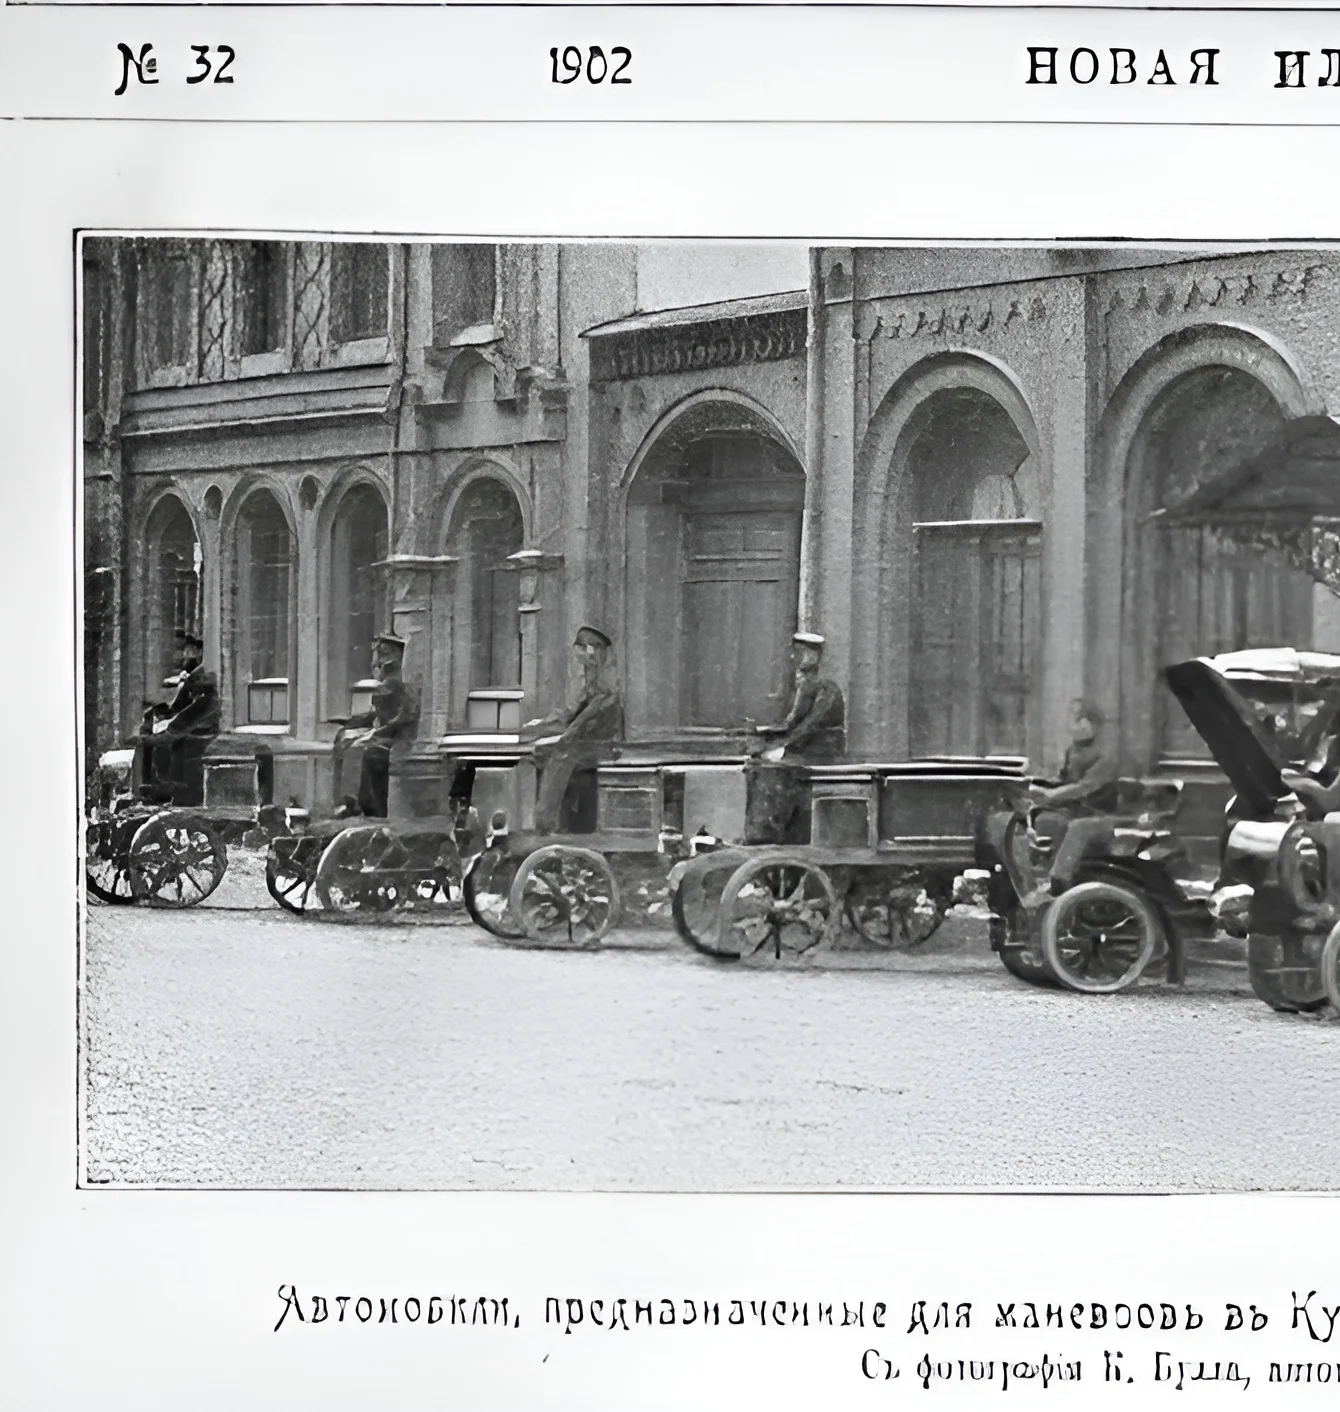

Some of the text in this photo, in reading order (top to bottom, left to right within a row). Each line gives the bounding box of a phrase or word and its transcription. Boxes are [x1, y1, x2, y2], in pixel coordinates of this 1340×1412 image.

[186, 44, 236, 85] 32
[549, 45, 632, 85] 1902
[1025, 46, 1221, 86] НОВАЯ
[906, 1300, 973, 1335] для
[1224, 1303, 1269, 1332] въ
